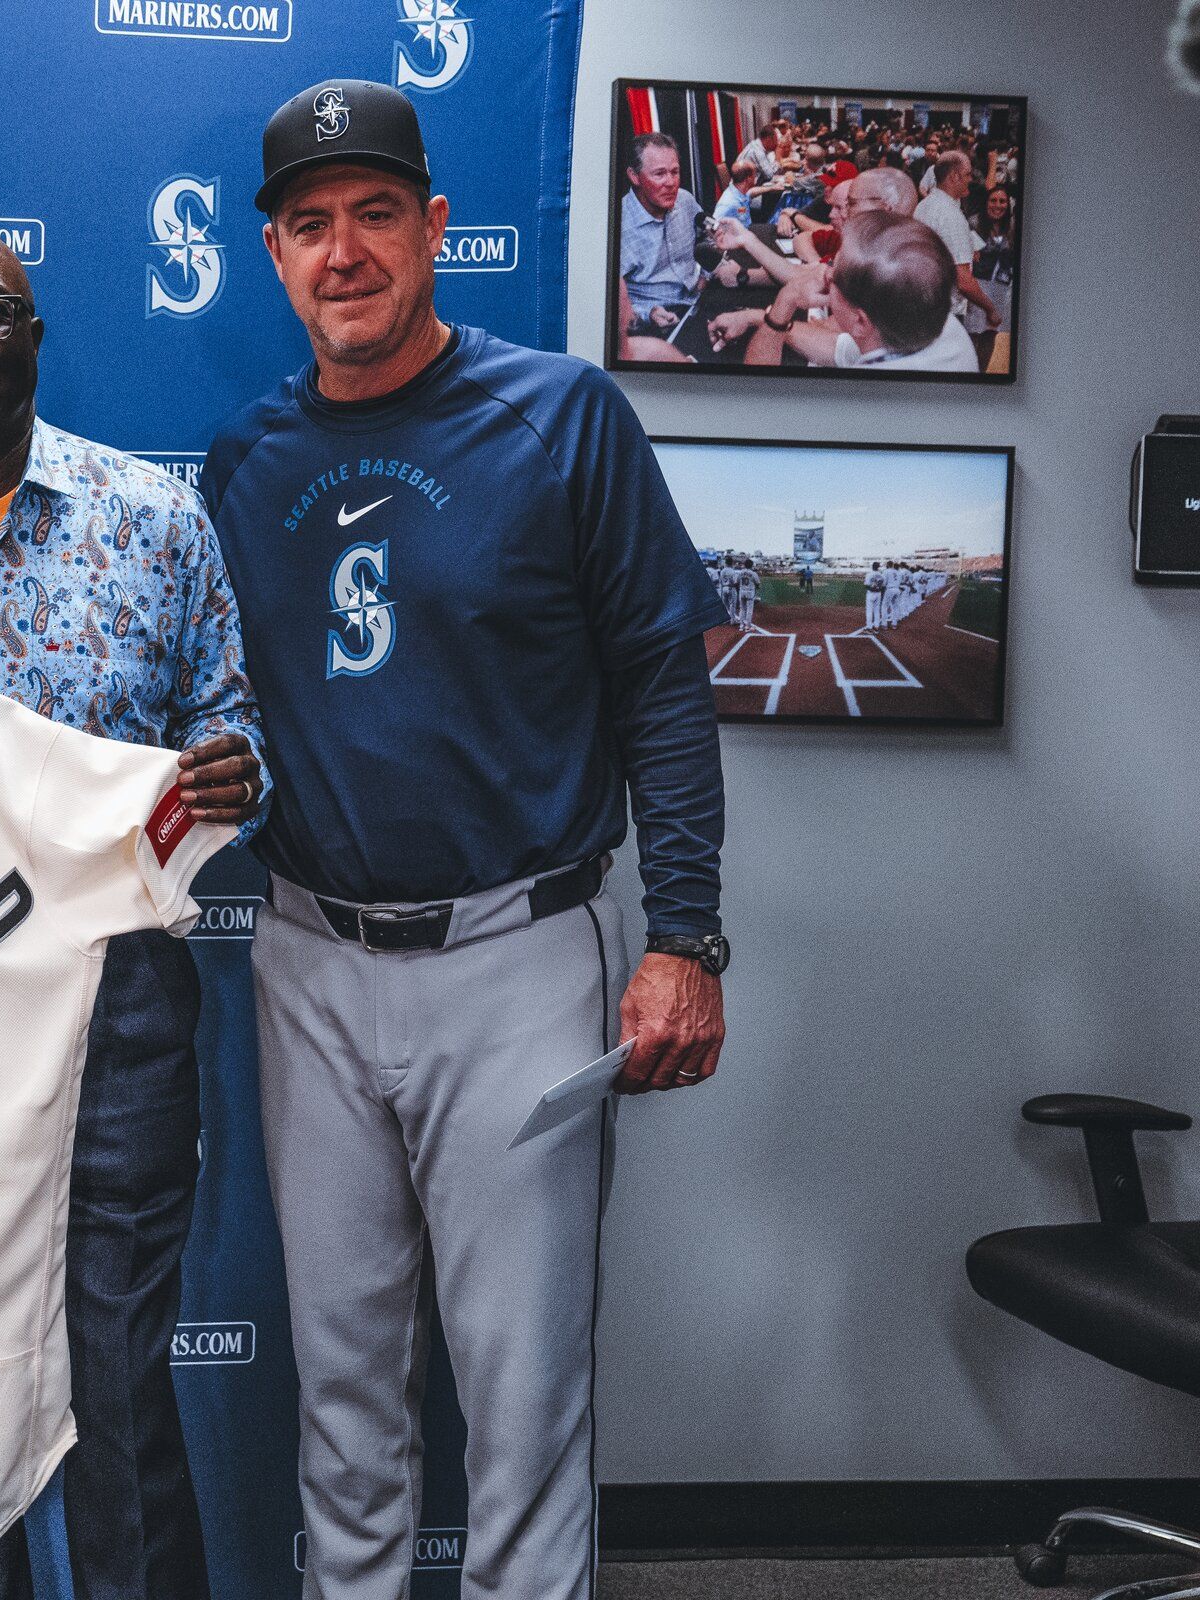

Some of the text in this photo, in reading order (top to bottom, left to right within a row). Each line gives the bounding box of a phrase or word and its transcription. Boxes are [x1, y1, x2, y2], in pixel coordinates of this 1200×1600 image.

[108, 0, 279, 31] MARINERS.COM
[314, 87, 351, 142] S
[145, 172, 227, 320] S
[434, 237, 505, 262] S.COM
[284, 458, 451, 532] SEATTLE BASEBALL
[326, 538, 399, 680] S
[193, 906, 254, 929] .COM
